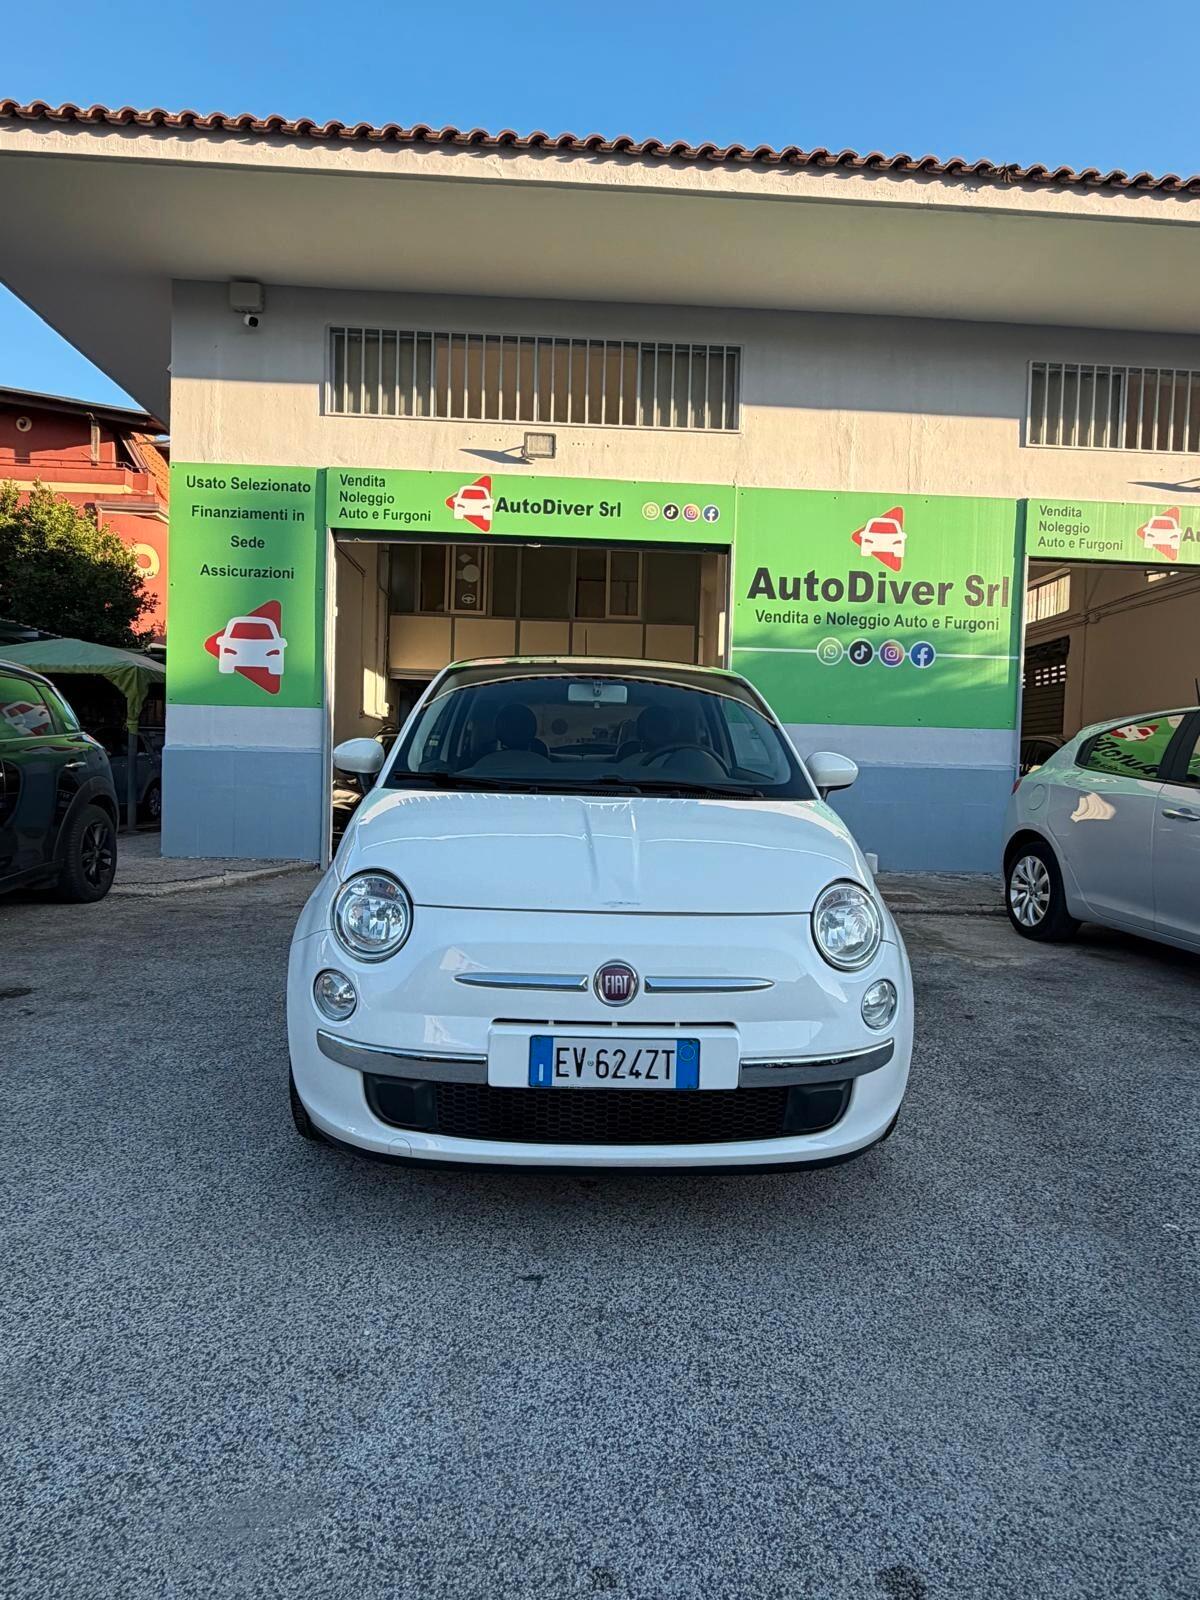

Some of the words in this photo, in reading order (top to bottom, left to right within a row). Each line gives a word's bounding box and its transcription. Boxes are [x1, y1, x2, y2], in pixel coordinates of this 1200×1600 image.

[186, 475, 226, 489] Usato
[230, 476, 311, 493] Selezionato
[340, 473, 386, 488] Vendita
[339, 490, 395, 506] Noleggio
[191, 505, 288, 521] Finanziamenti
[292, 508, 305, 522] in
[339, 507, 369, 520] Auto
[372, 510, 379, 520] e
[383, 508, 431, 524] Furgoni
[495, 497, 594, 516] AutoDiver
[599, 501, 621, 518] Srl
[1039, 505, 1082, 518] Vendita
[1038, 520, 1091, 536] Noleggio
[230, 535, 265, 549] Sede
[1037, 536, 1066, 548] Auto
[1068, 539, 1076, 549] e
[1078, 537, 1123, 552] Furgoni
[199, 563, 295, 580] Assicurazioni
[746, 566, 954, 606] AutoDiver
[964, 574, 1010, 608] Srl
[755, 609, 809, 625] Vendita
[813, 613, 822, 625] e
[826, 611, 891, 630] Noleggio
[893, 614, 928, 629] Auto
[932, 617, 940, 629] e
[944, 615, 1000, 634] Furgoni
[604, 975, 630, 994] FIAT
